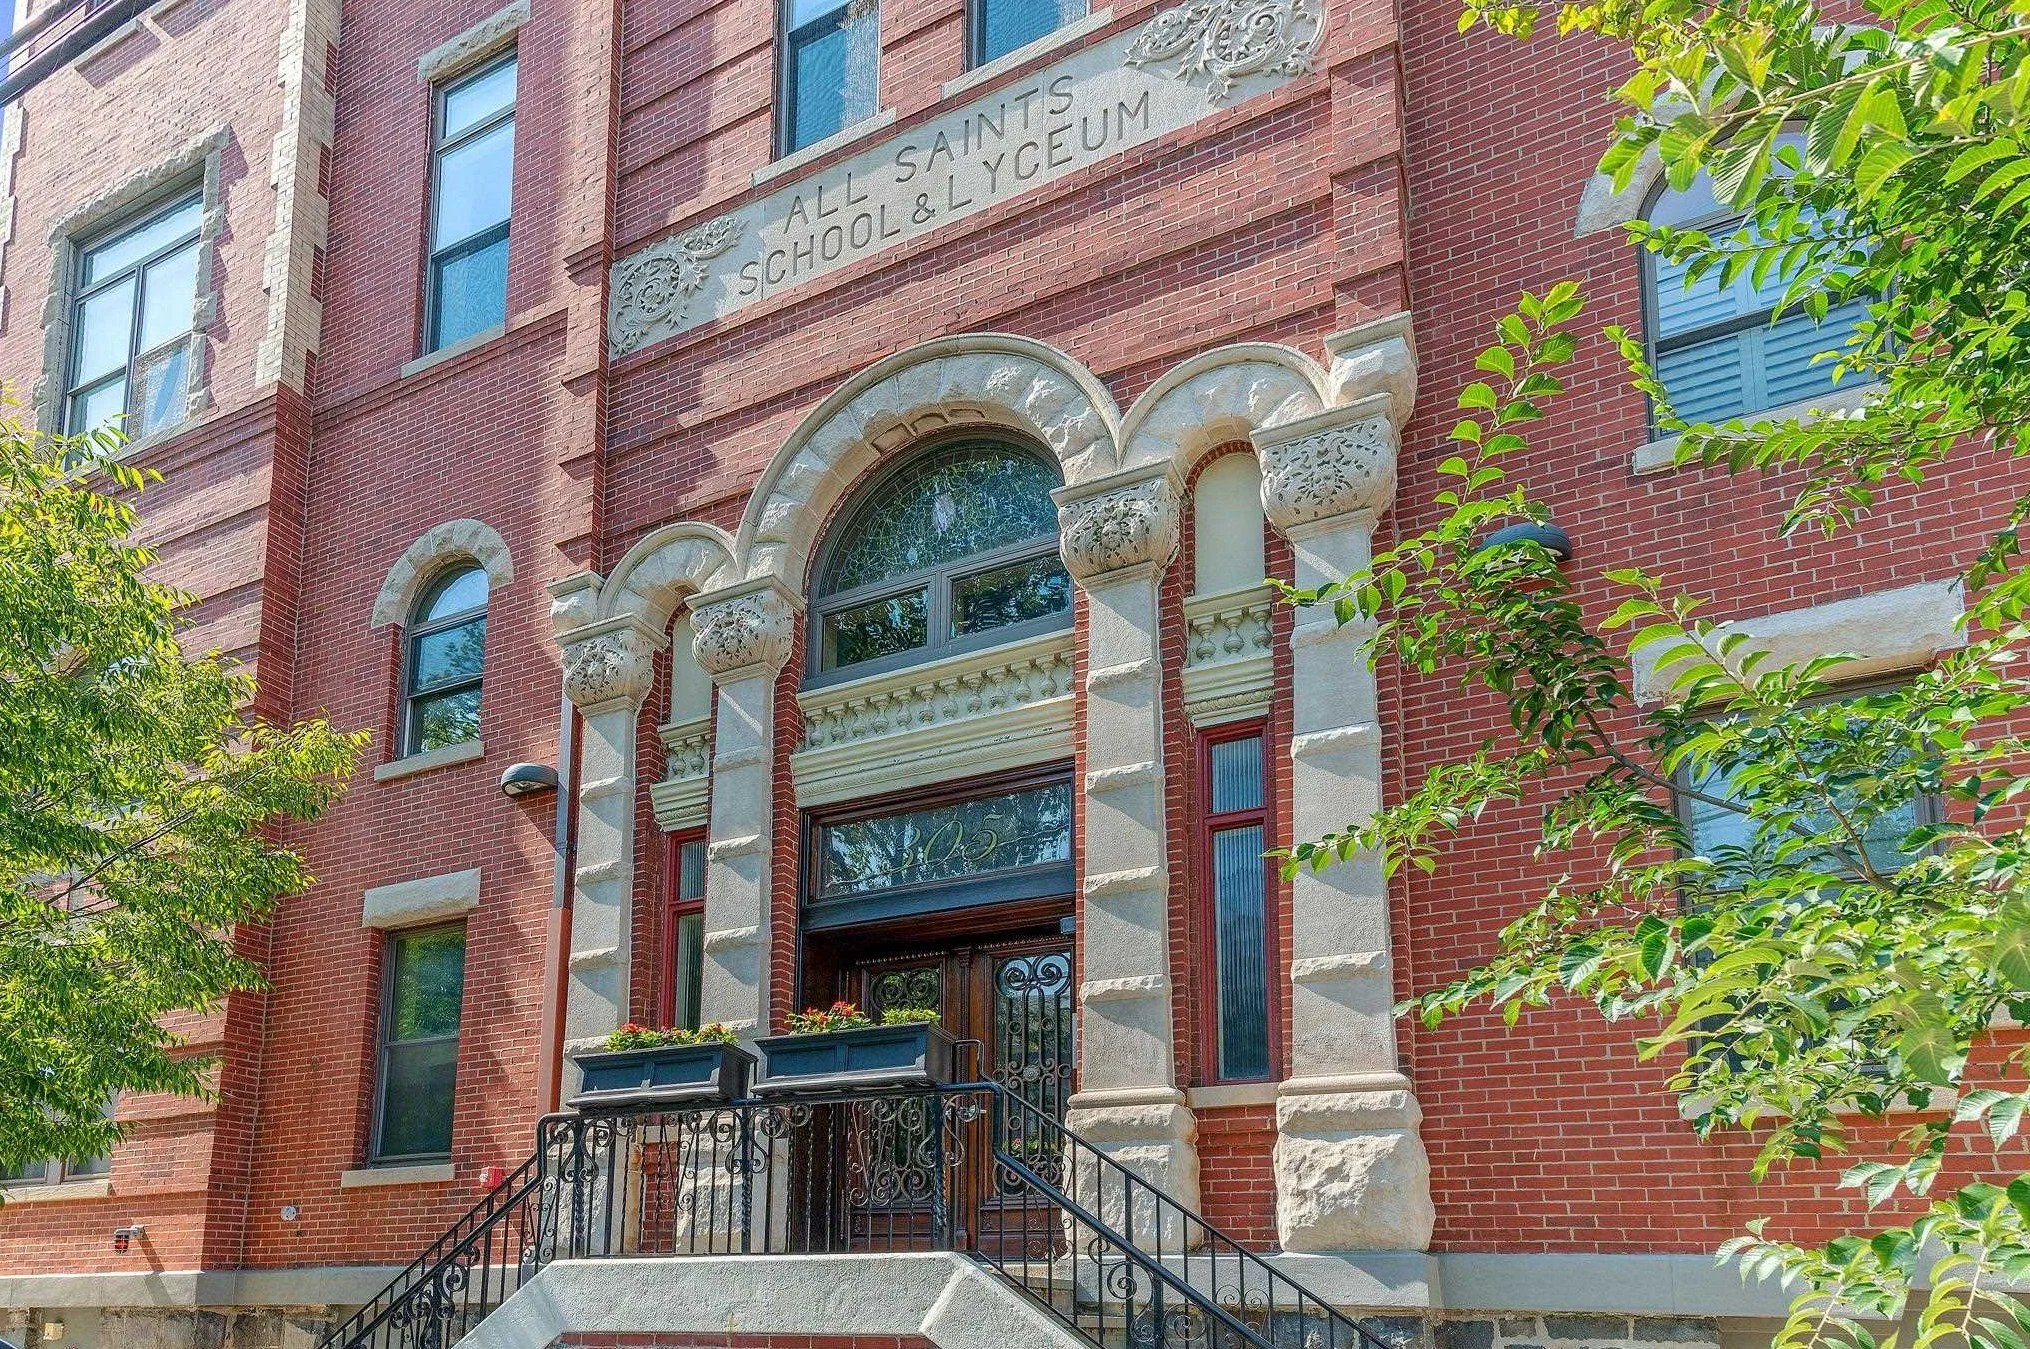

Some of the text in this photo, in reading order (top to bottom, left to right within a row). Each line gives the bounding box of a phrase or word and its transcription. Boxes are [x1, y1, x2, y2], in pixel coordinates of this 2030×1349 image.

[738, 91, 1150, 297] SCHOOL & LYCEUM
[784, 75, 1074, 234] ALL SAINTS
[881, 813, 1003, 873] 305
